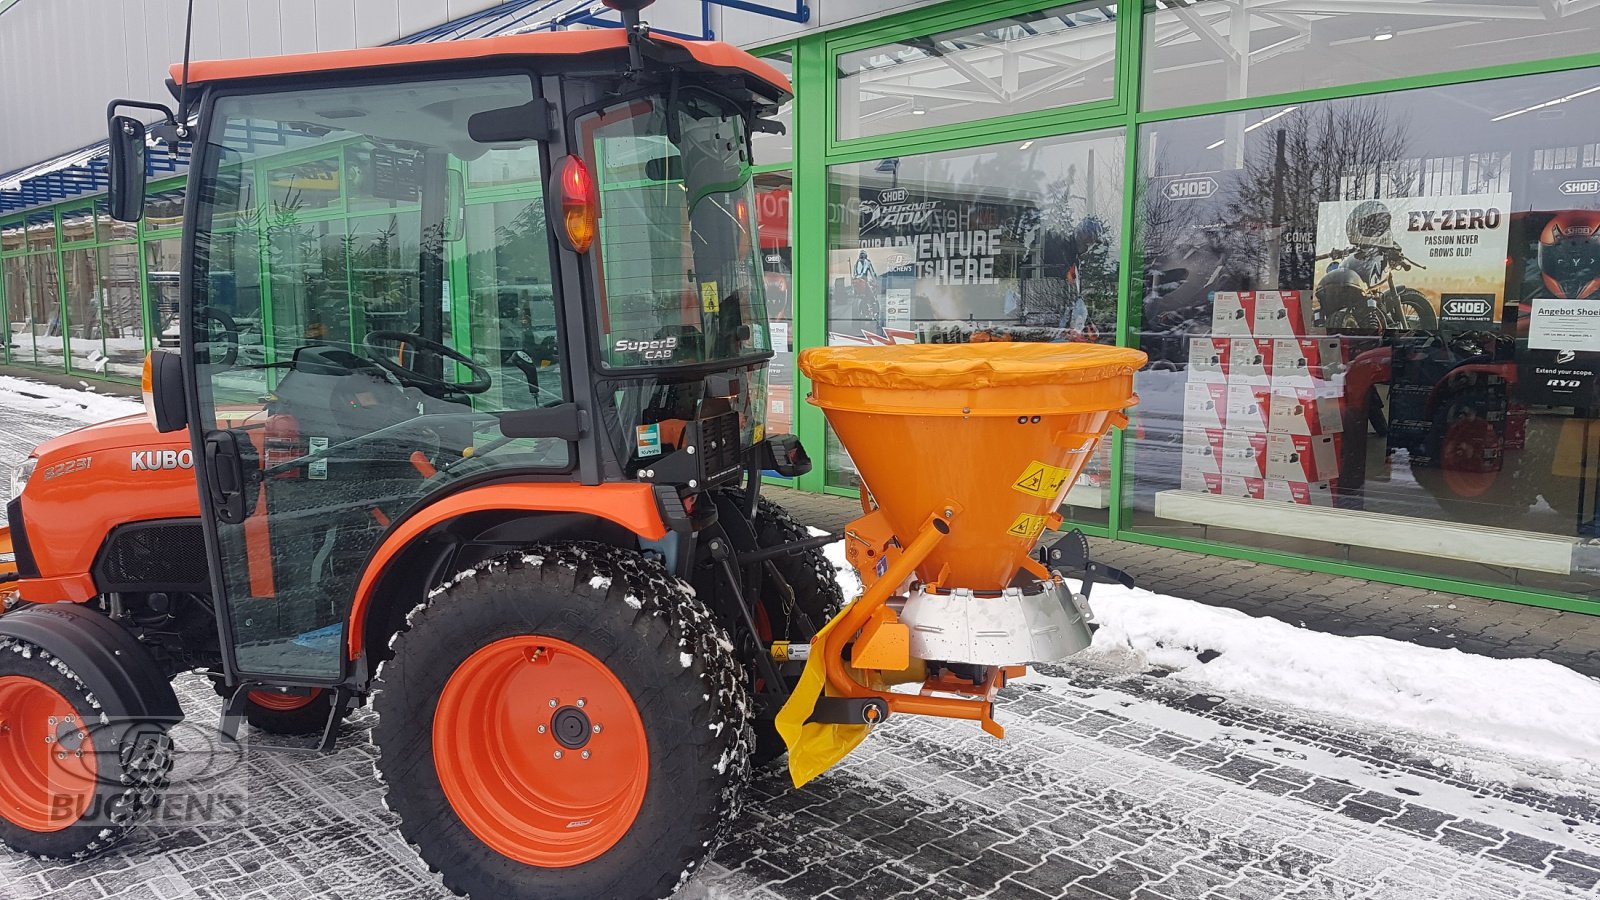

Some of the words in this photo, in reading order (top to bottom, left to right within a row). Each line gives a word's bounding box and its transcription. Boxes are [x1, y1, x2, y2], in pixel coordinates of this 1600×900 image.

[1170, 181, 1211, 197] SHOEI
[1565, 182, 1598, 193] SHOEI
[882, 190, 905, 203] SHOEI
[880, 210, 934, 227] ADV
[1407, 208, 1501, 232] EX-ZERO
[1286, 232, 1314, 243] COME
[1424, 236, 1455, 246] PASSION
[1456, 234, 1479, 245] NEVER
[1429, 248, 1454, 258] GROWS
[1456, 247, 1473, 257] OLD!
[935, 257, 1000, 286] HERE.
[1449, 302, 1485, 314] SHOEI
[1538, 308, 1575, 316] Angebot
[645, 350, 672, 359] CAB
